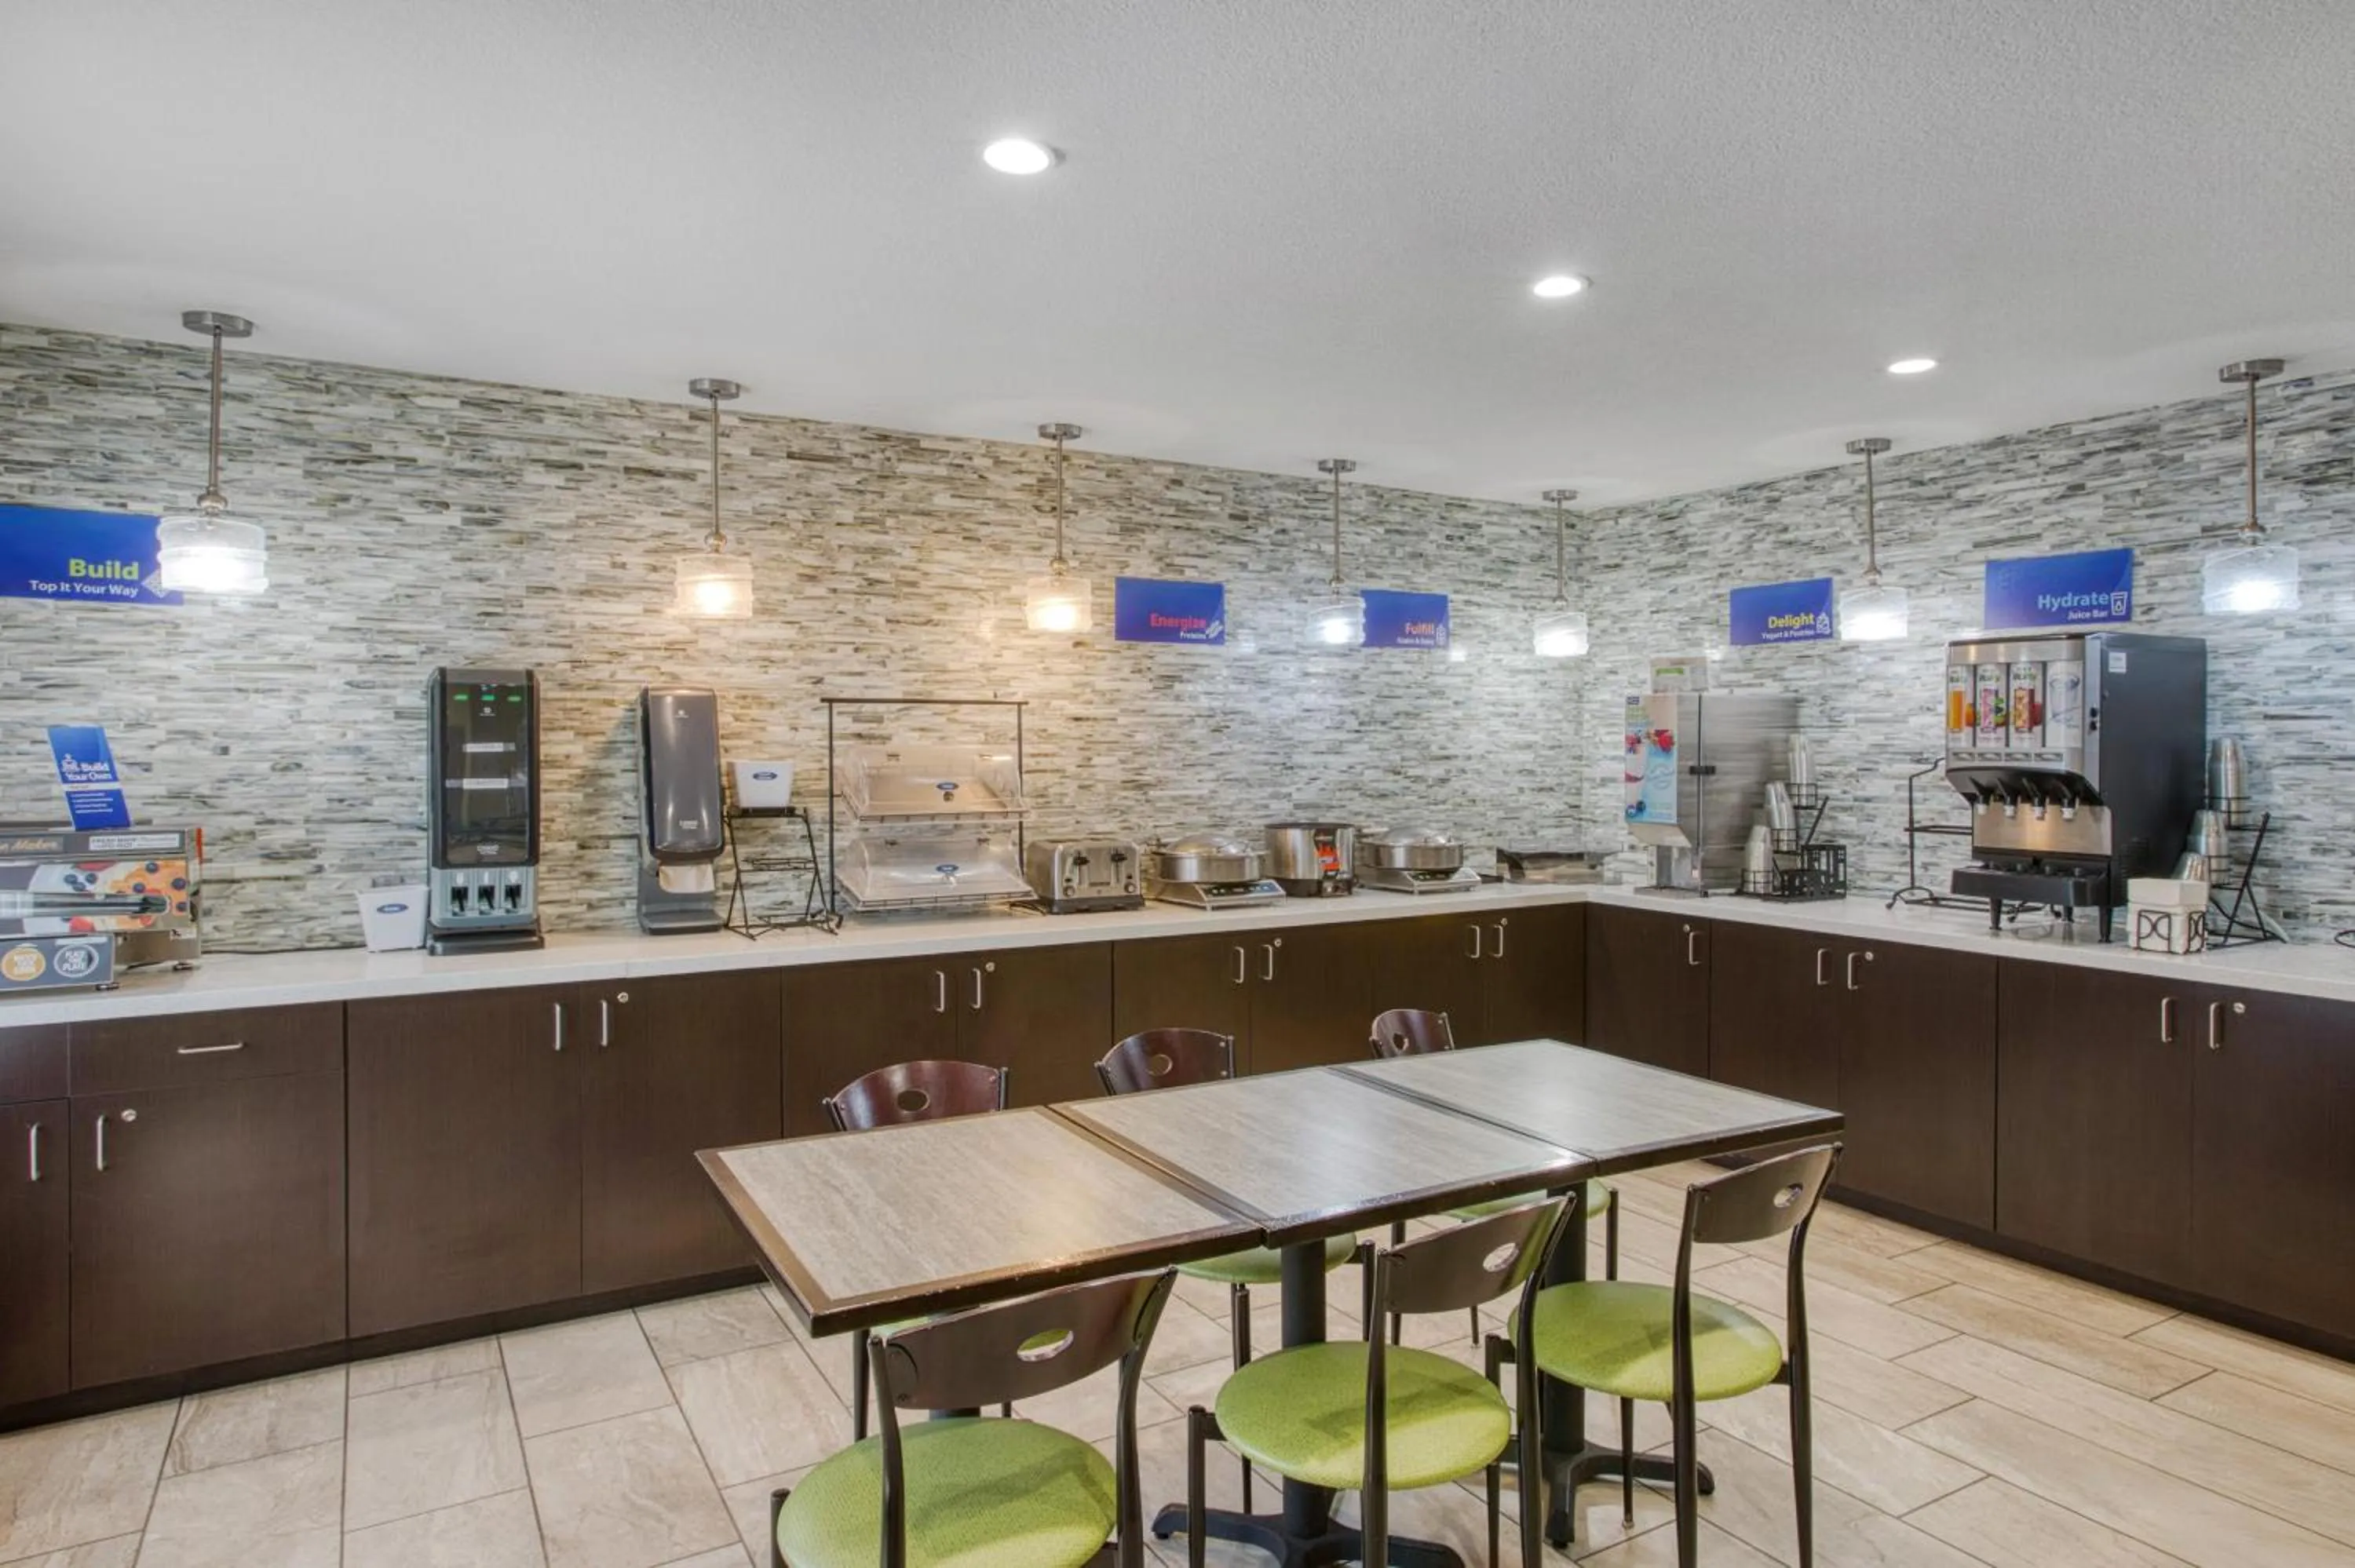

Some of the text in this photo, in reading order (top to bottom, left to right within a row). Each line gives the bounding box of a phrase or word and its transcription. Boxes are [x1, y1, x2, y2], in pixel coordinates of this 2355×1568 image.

[69, 558, 139, 580] Build
[28, 580, 140, 598] Top It Your Way
[2038, 592, 2109, 611] Hydrate
[1768, 613, 1815, 629] Delight
[2068, 609, 2108, 620] Juice Bar
